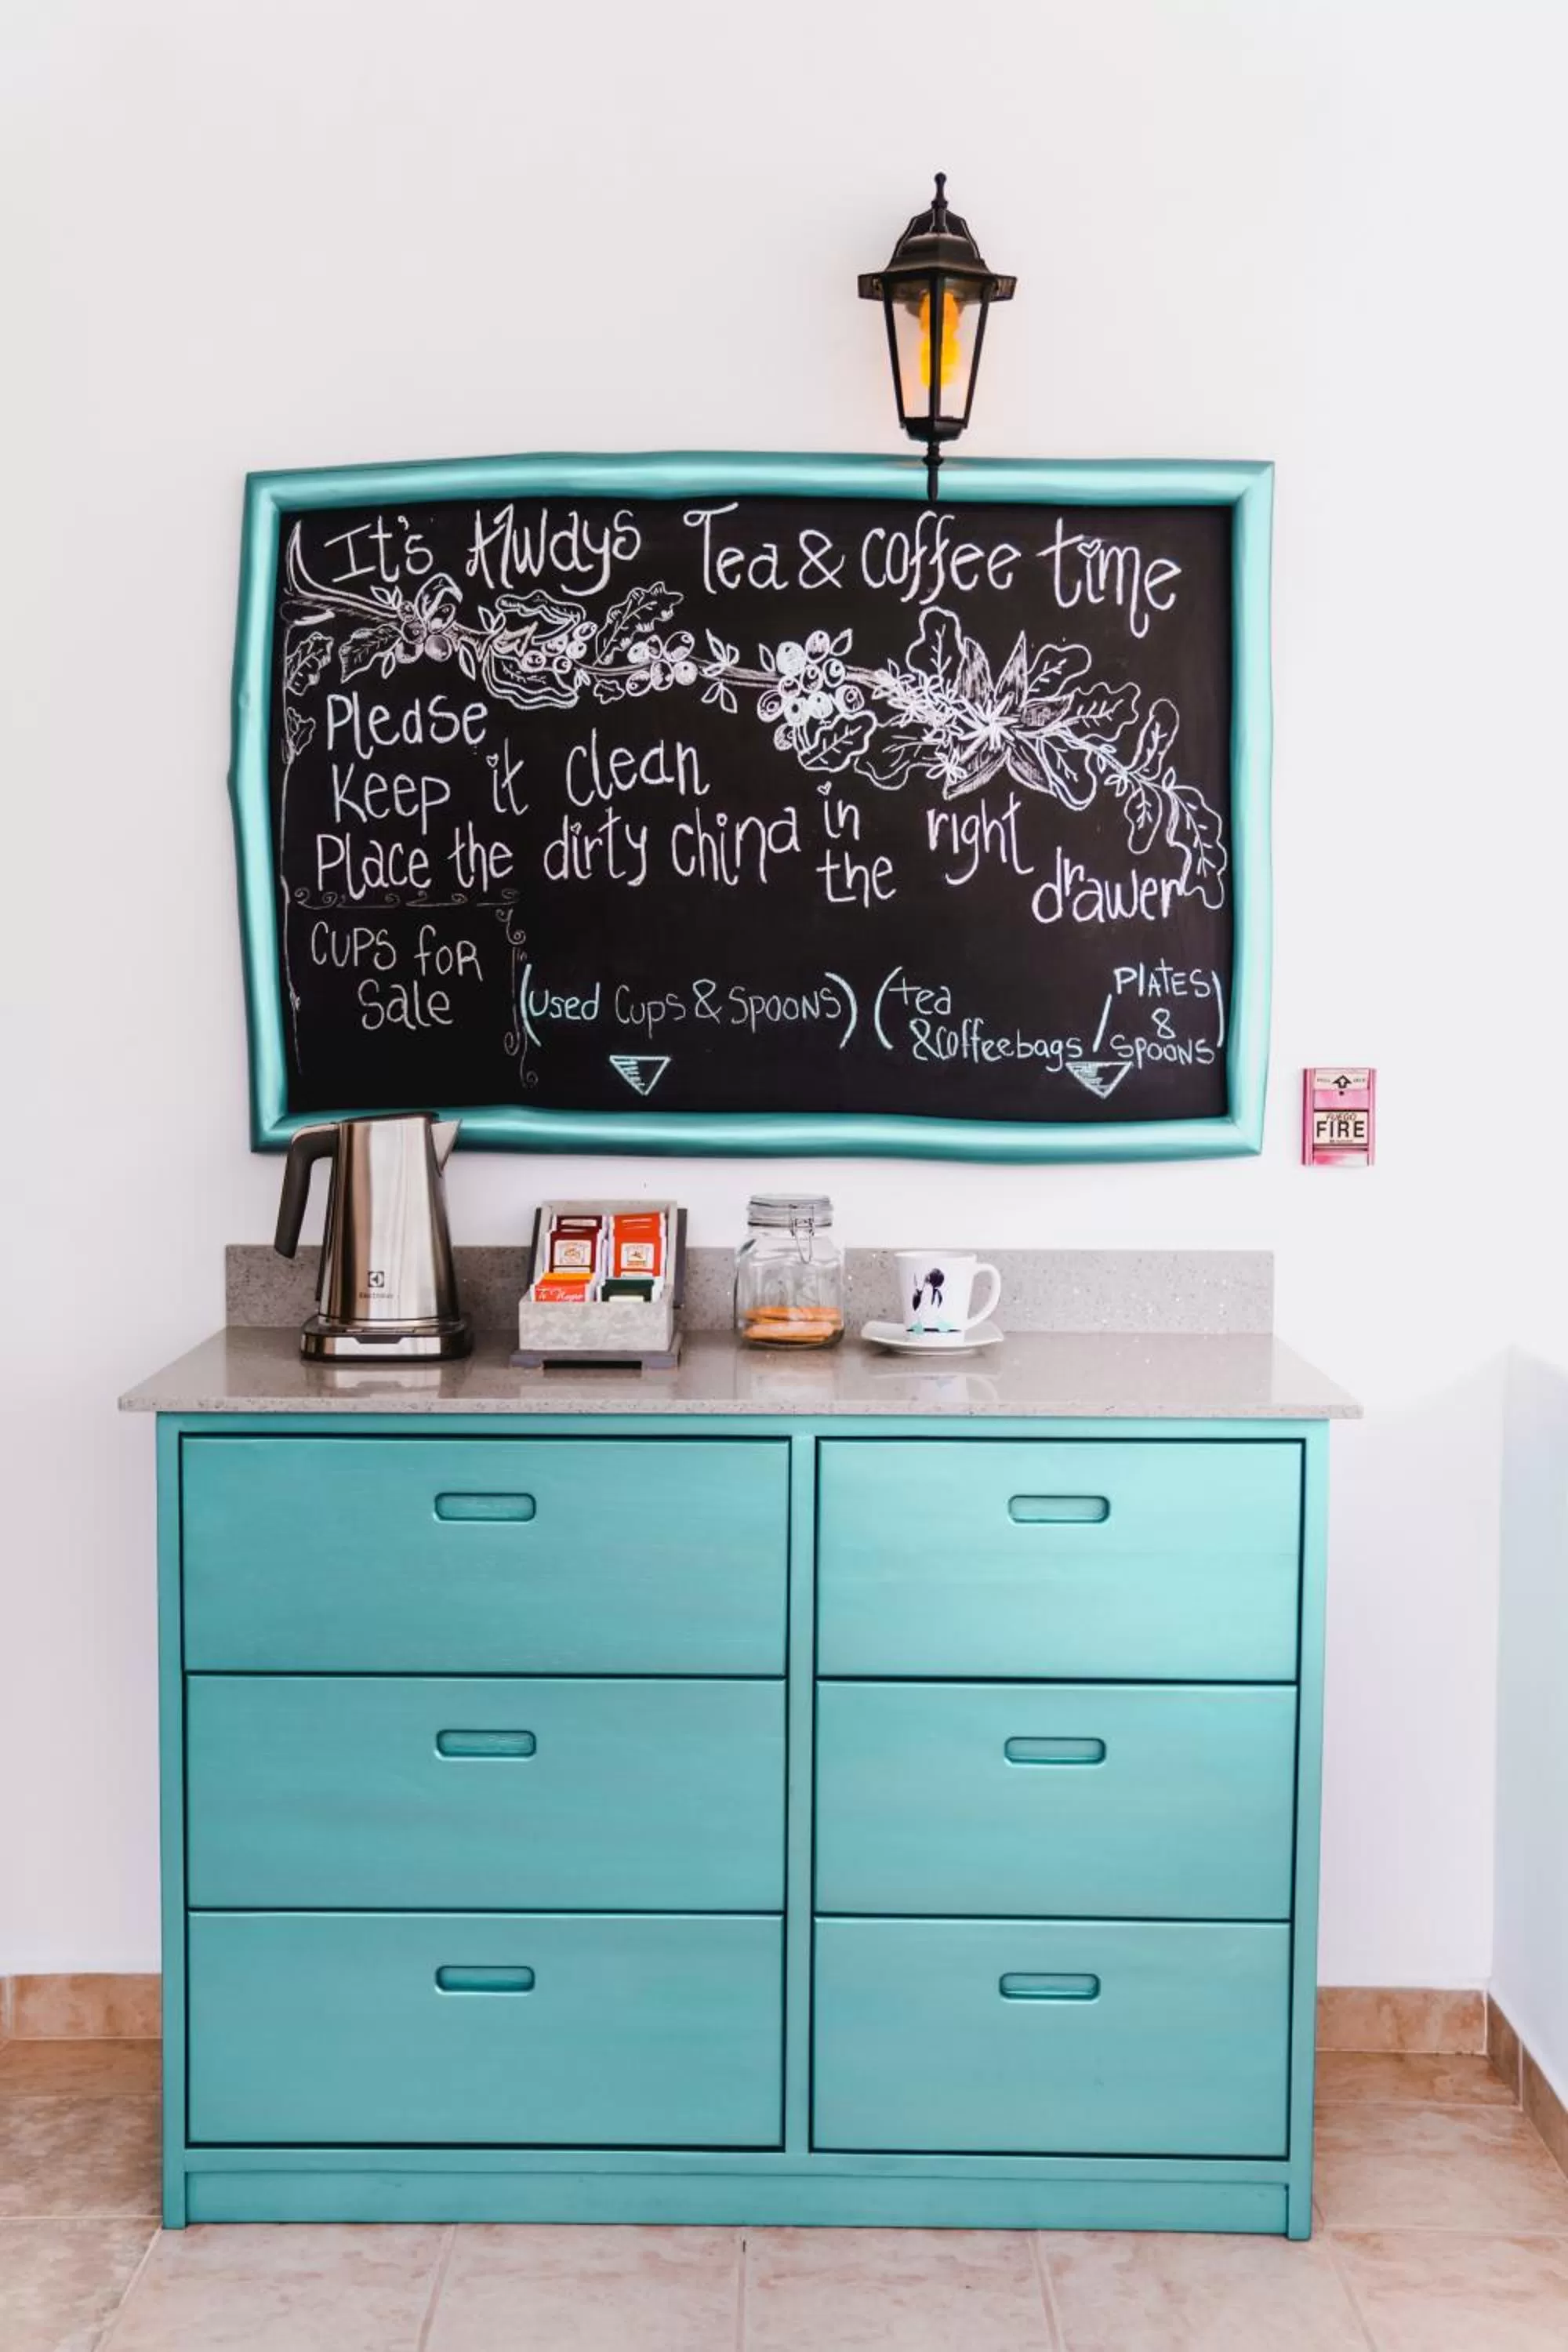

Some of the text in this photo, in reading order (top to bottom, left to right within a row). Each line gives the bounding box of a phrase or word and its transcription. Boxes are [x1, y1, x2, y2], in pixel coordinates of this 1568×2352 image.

[325, 514, 434, 584] It's
[682, 503, 788, 593] Tea
[798, 529, 845, 589] &
[1036, 518, 1181, 638] time
[332, 764, 451, 834] Keep
[486, 737, 529, 815] it
[317, 782, 1183, 923] Place the dirty china in the right drawer
[692, 978, 722, 1024] &
[1316, 1120, 1365, 1138] FIRE
